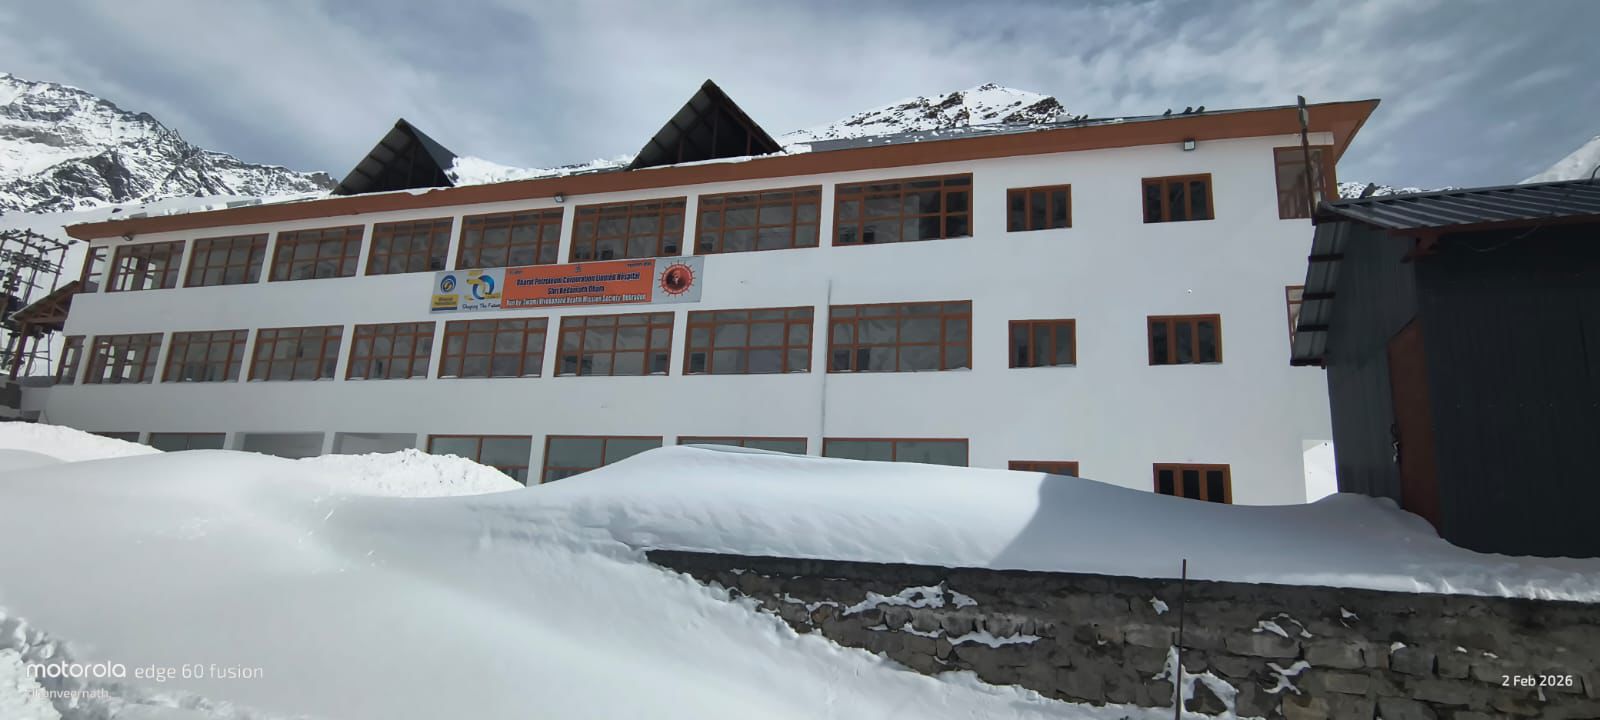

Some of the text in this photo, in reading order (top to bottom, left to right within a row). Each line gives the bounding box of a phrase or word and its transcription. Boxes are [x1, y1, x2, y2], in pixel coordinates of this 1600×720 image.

[535, 277, 562, 286] Petroleum
[562, 275, 596, 284] Corporation
[596, 273, 616, 281] Limited
[617, 272, 641, 281] Hospital
[560, 285, 588, 294] Kedarnath
[589, 285, 605, 293] Dham
[462, 303, 478, 311] Shaping
